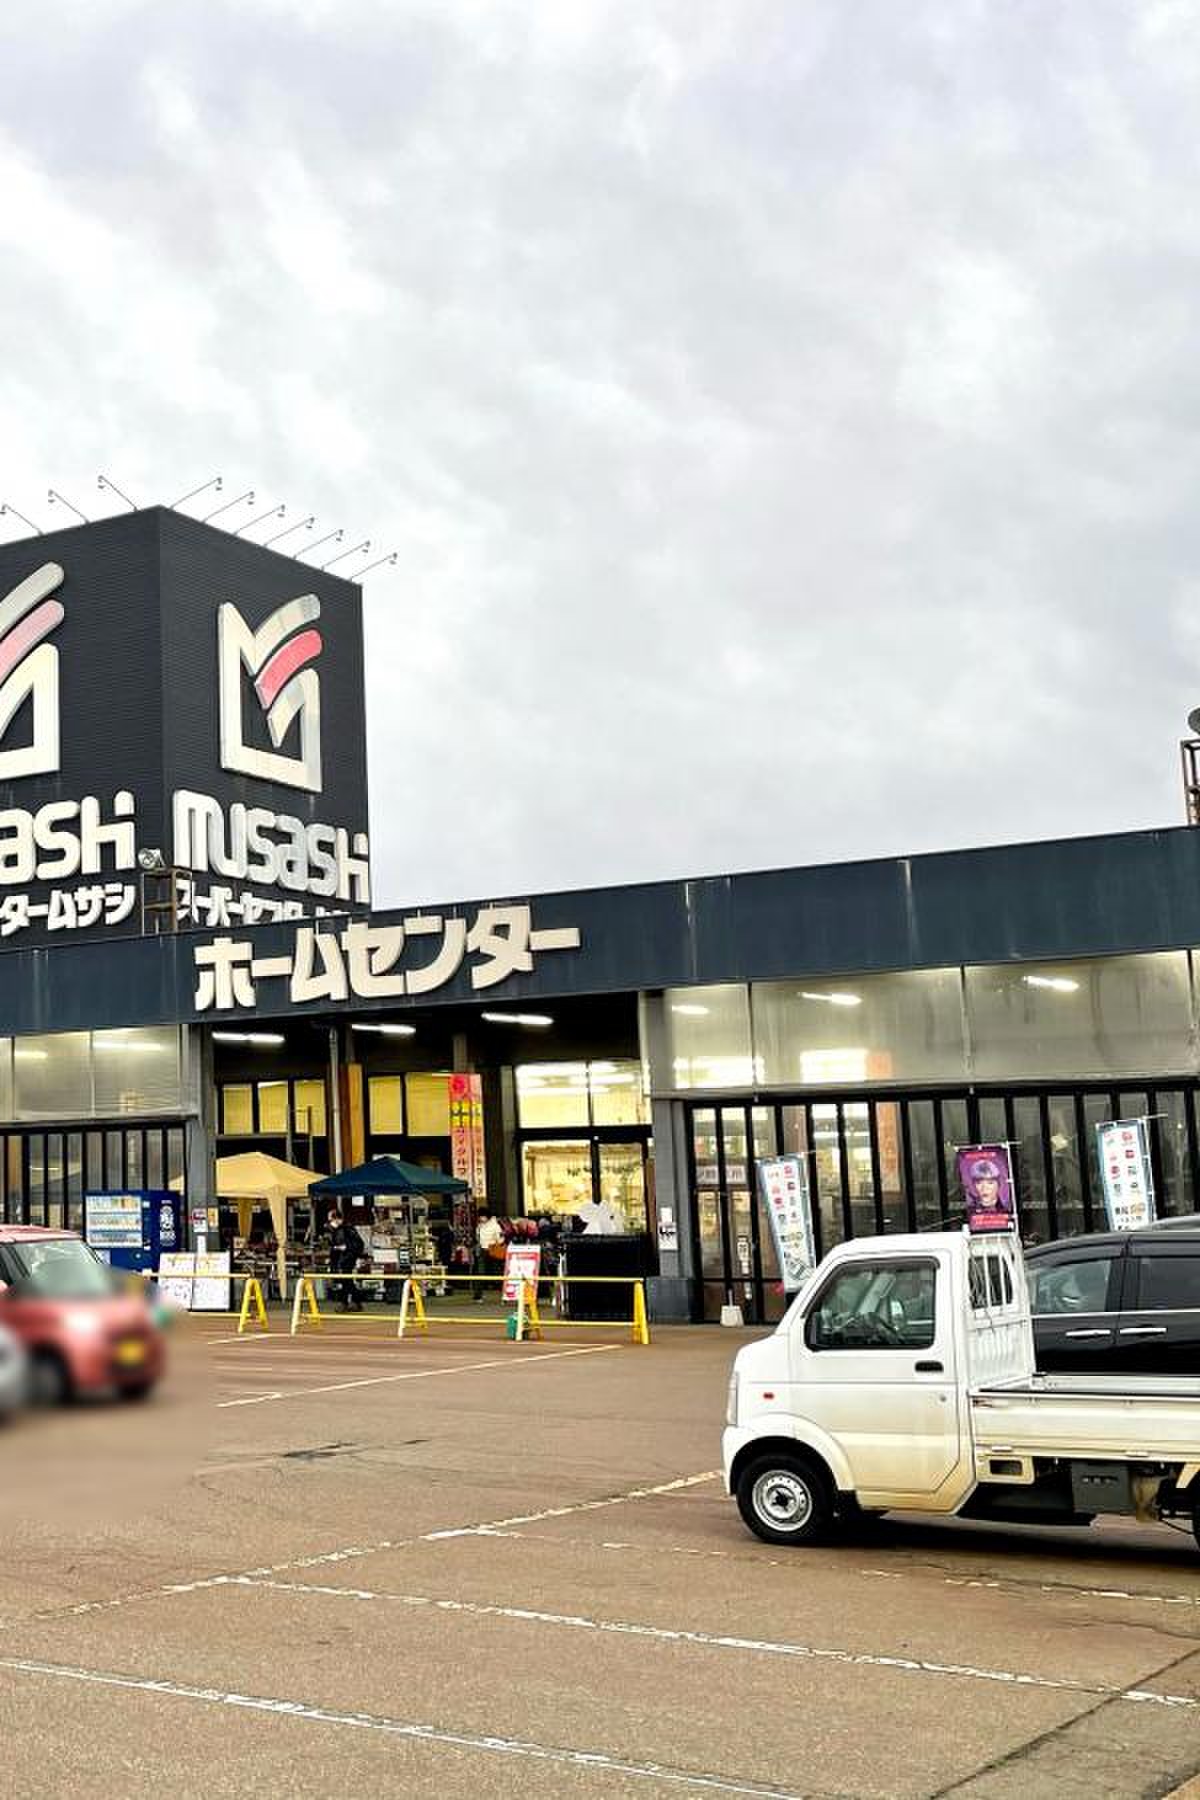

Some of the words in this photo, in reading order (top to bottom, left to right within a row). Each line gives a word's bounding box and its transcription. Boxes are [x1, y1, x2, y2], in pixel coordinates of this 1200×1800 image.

[194, 905, 581, 1011] ホームセンター
